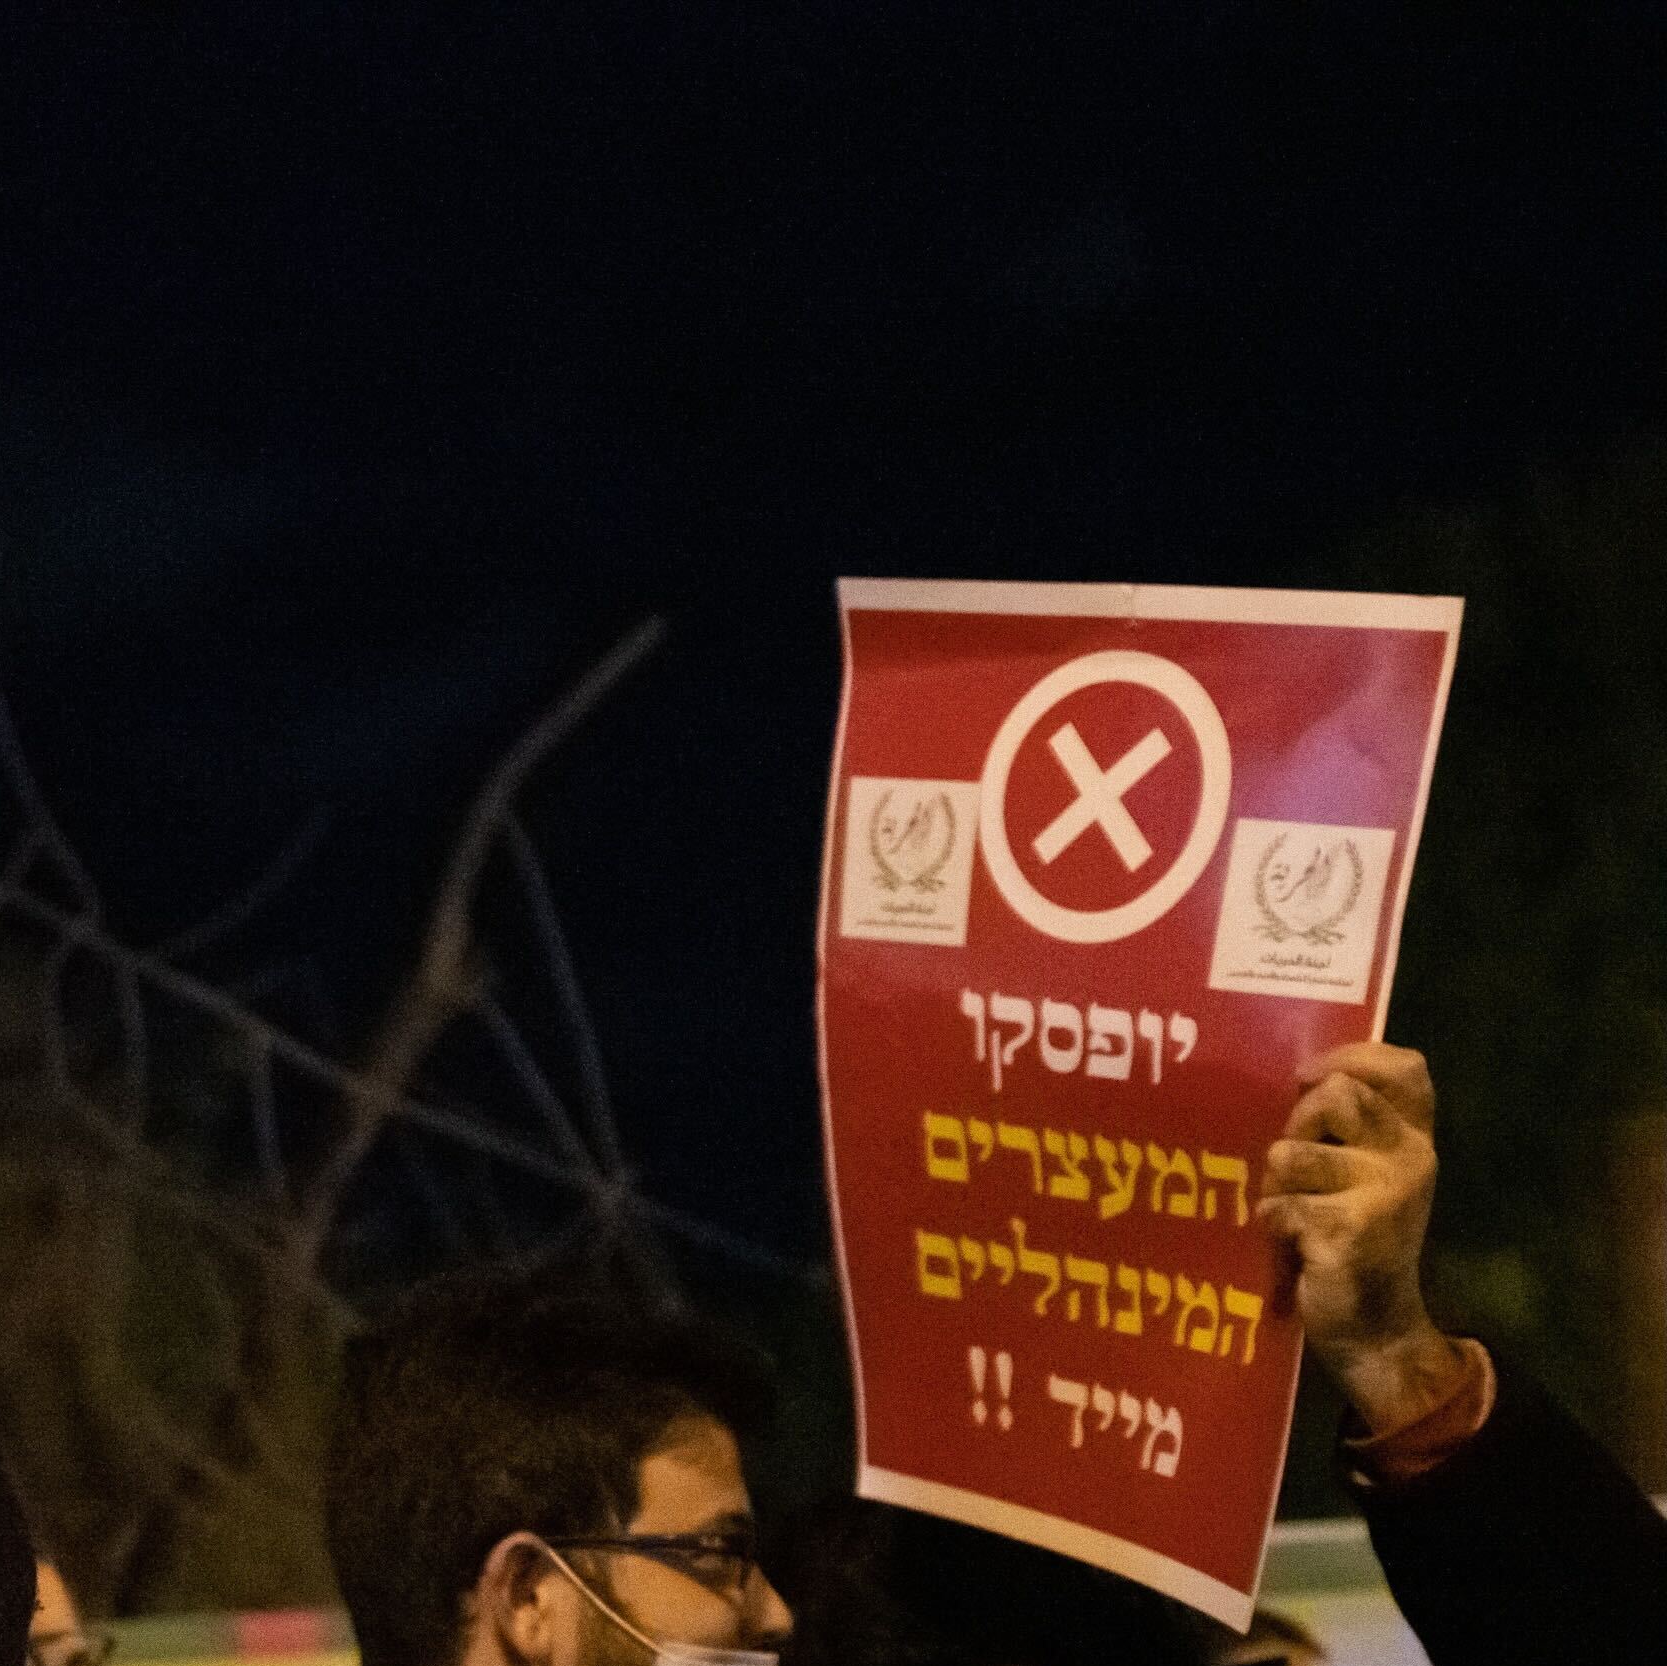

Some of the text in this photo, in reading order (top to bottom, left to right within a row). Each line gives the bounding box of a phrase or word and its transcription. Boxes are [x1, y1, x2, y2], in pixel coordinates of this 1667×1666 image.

[960, 988, 1198, 1091] יופסקו
[922, 1110, 1249, 1228] המעצרים
[915, 1217, 1263, 1366] המינהליים
[1047, 1373, 1184, 1478] מייד
